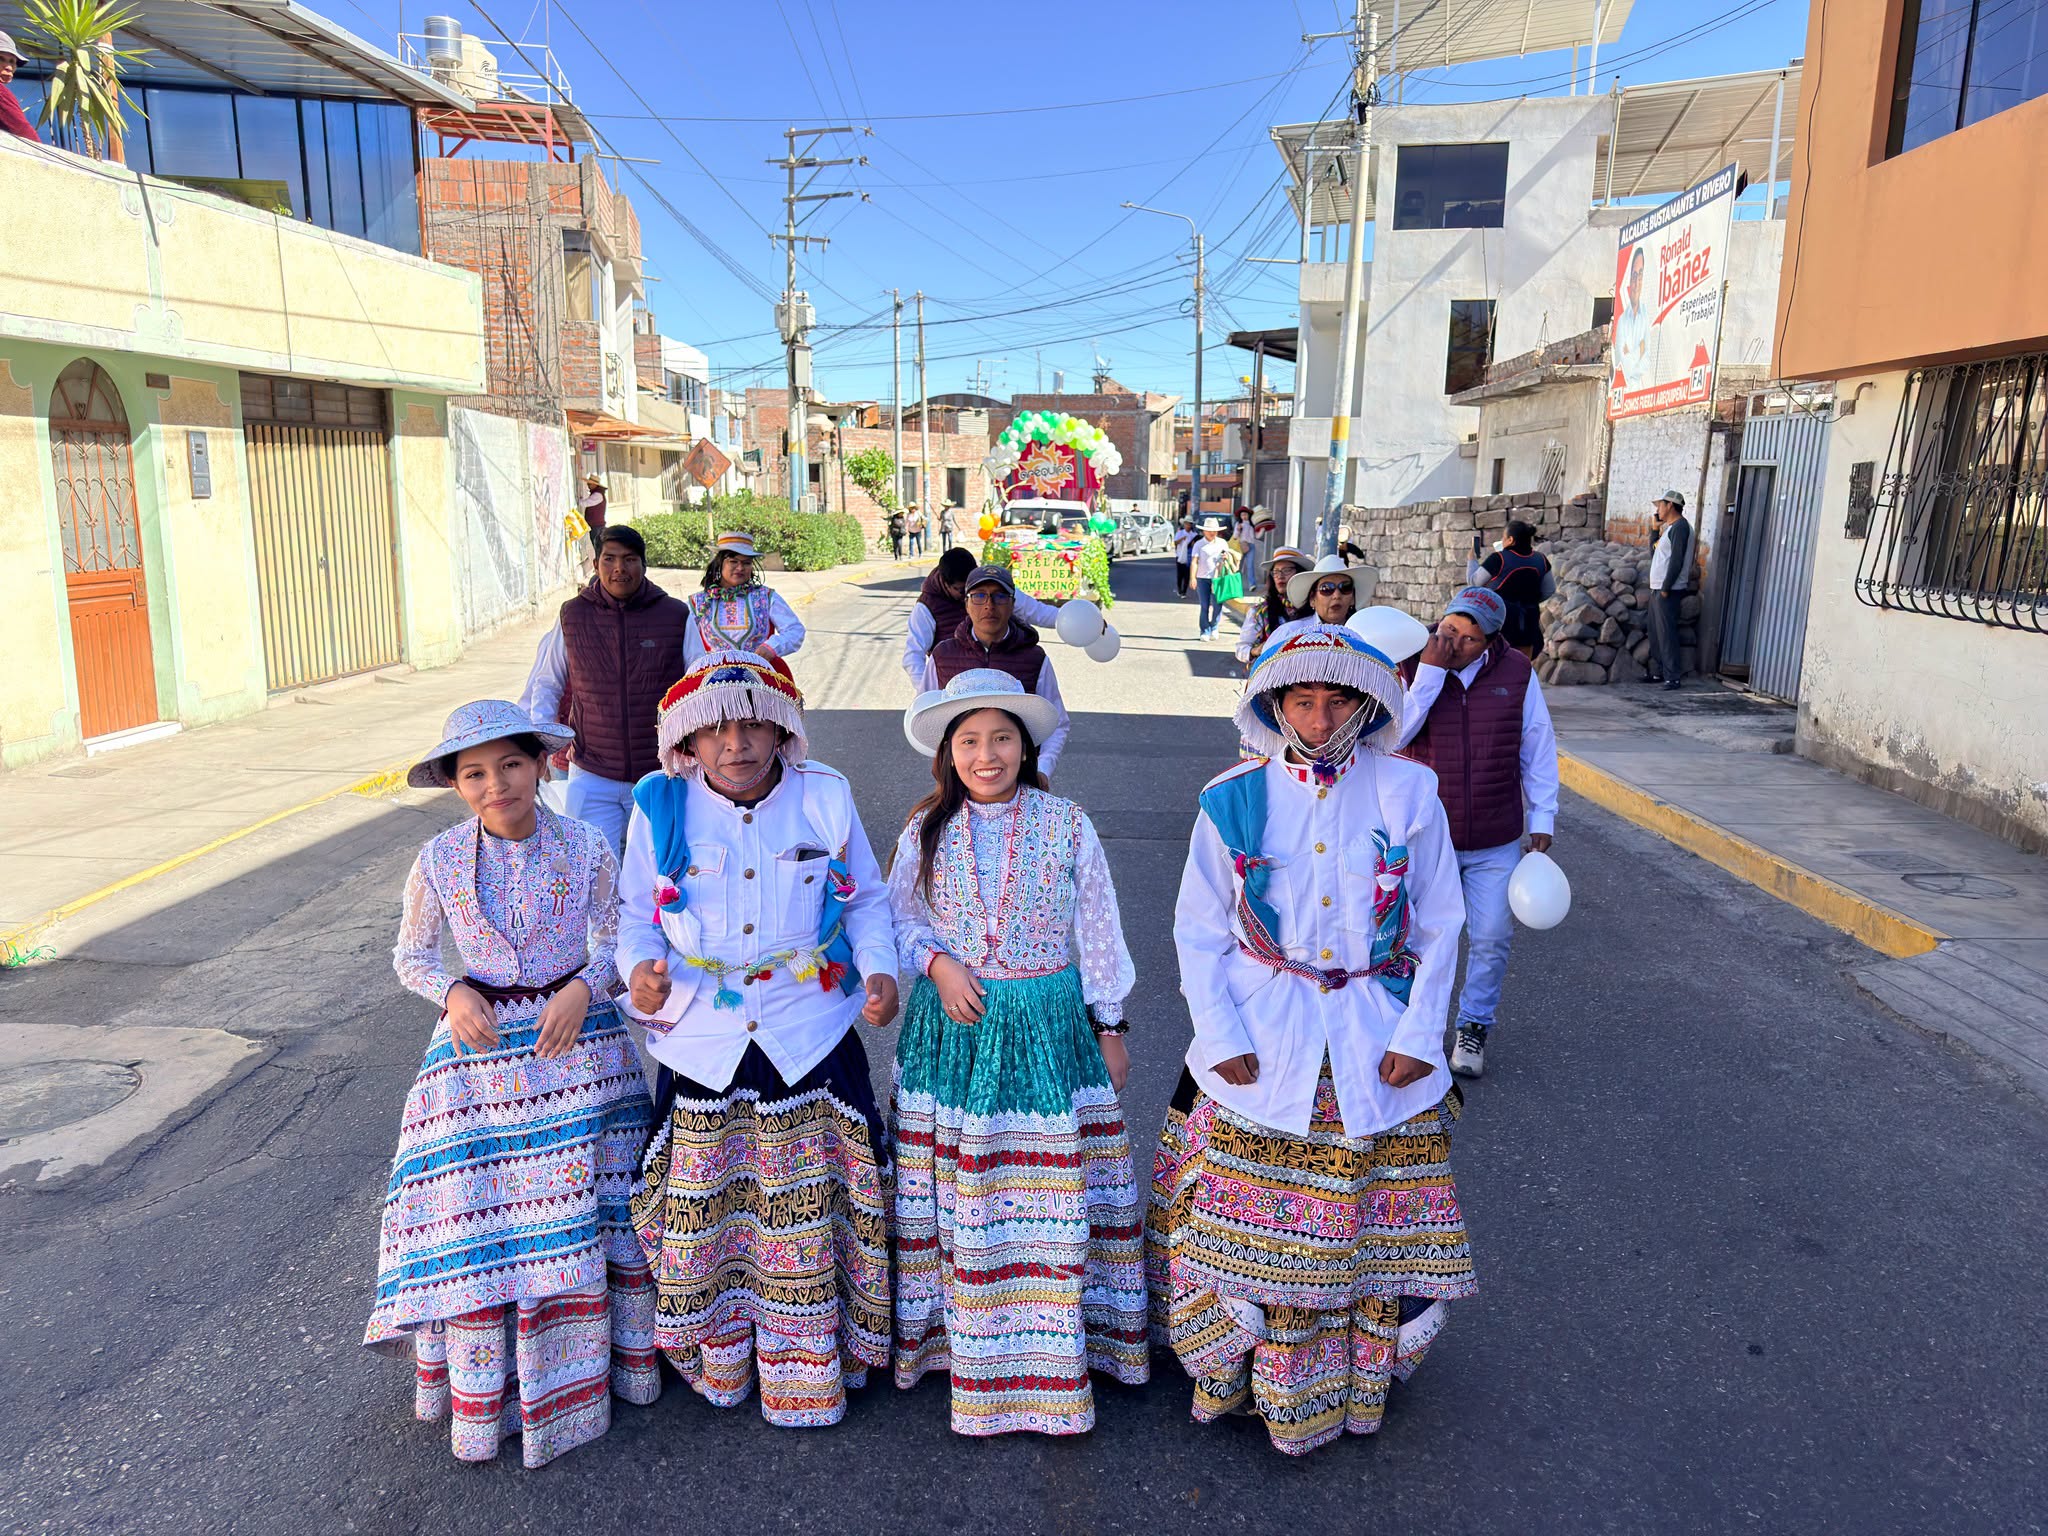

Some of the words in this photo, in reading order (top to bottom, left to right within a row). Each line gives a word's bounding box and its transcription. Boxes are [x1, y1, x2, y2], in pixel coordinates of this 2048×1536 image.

[1621, 217, 1649, 246] ALCALDE
[1649, 192, 1695, 232] BUSTAMANTE
[1695, 186, 1703, 206] Y
[1701, 170, 1732, 202] RIVERO
[1660, 223, 1692, 268] Ronald
[1657, 246, 1711, 308] Ibáñez
[1679, 287, 1717, 316] ¡Experiencia
[1685, 314, 1691, 328] y
[1691, 302, 1716, 323] Trabajo!
[1692, 368, 1703, 389] FA
[1613, 389, 1622, 410] FA
[1022, 569, 1041, 579] DIA
[1027, 557, 1065, 568] FELIZ
[1019, 580, 1075, 592] AMPESINO
